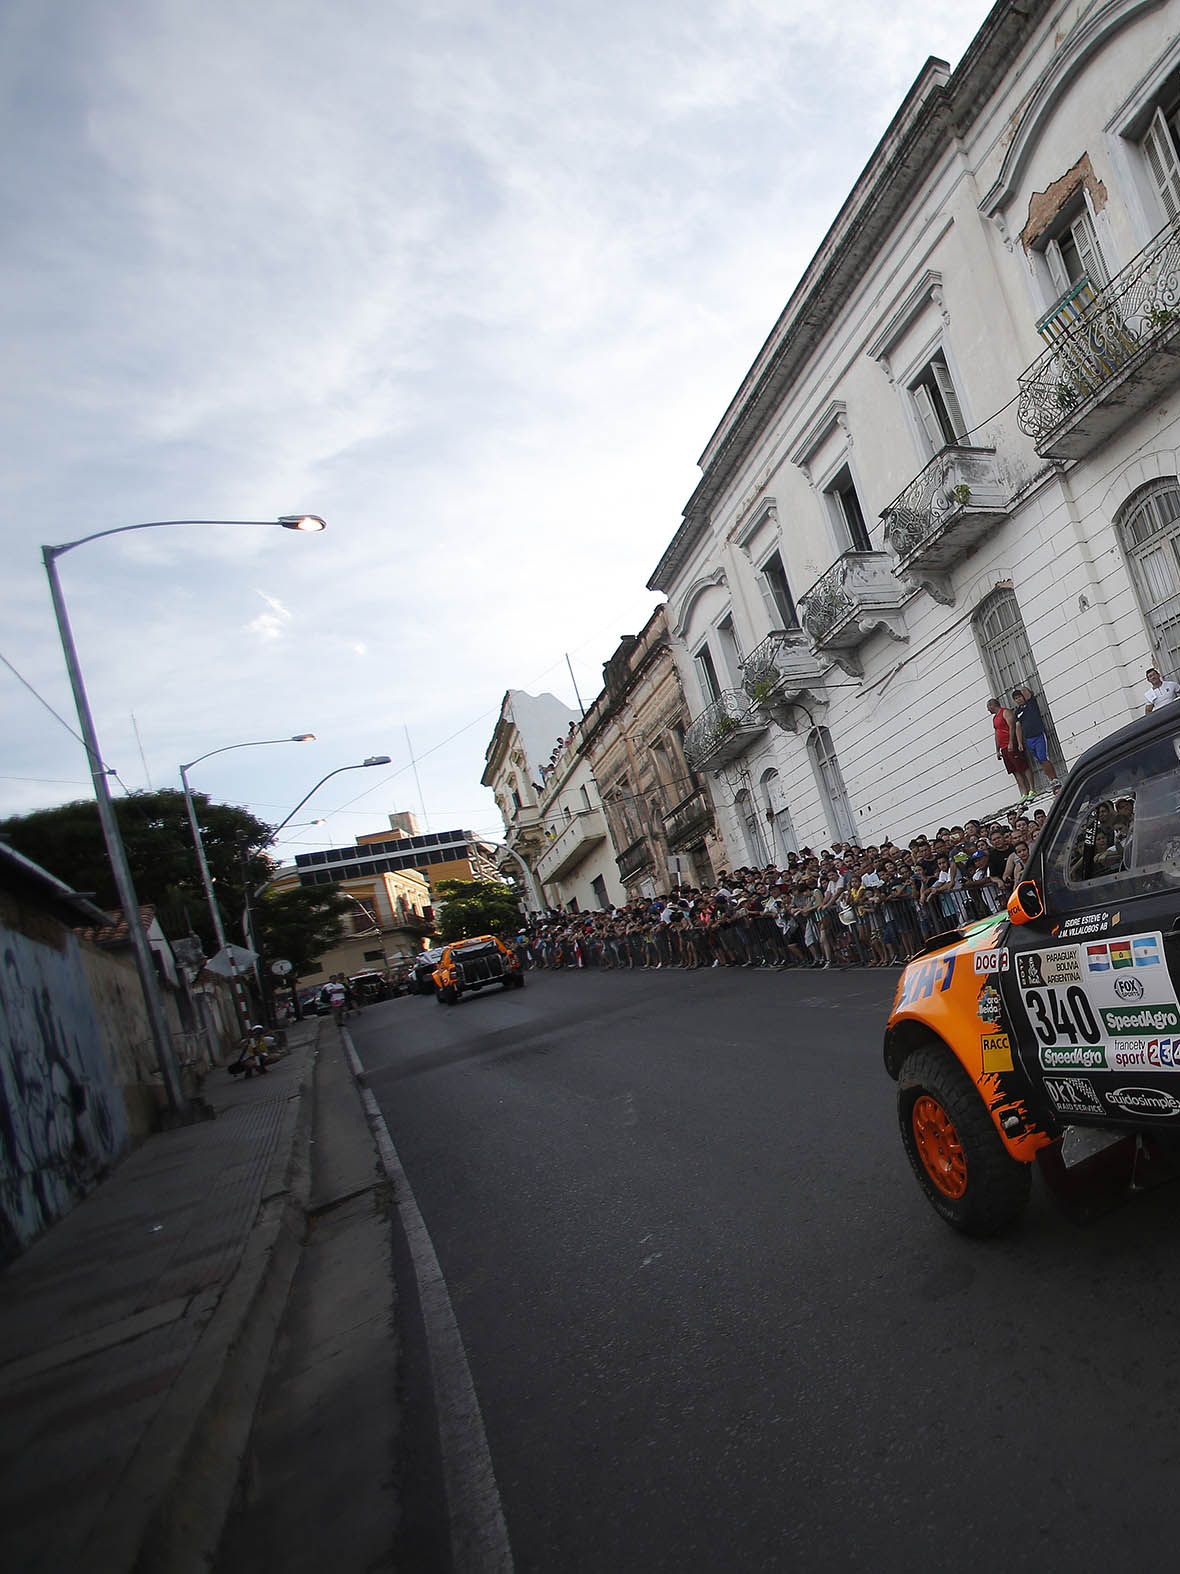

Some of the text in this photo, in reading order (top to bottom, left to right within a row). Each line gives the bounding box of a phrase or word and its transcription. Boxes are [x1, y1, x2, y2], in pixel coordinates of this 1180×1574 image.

[1065, 917, 1081, 928] ISIDRE
[1082, 913, 1101, 925] ESTEVE
[1069, 924, 1099, 936] VILLALOBOS
[1046, 950, 1077, 963] PARAGUAY
[1056, 961, 1079, 971] BOLIVIA
[1047, 972, 1080, 984] ARGENTINA
[1119, 980, 1137, 992] FOX
[1026, 986, 1101, 1046] 340
[1106, 1011, 1177, 1031] SpeedAgro
[983, 1038, 1009, 1050] RACC
[1114, 1039, 1145, 1050] francetv
[1045, 1048, 1102, 1067] SpeedAgro
[1116, 1051, 1145, 1067] sport
[1057, 1103, 1104, 1113] RAID SERVICE
